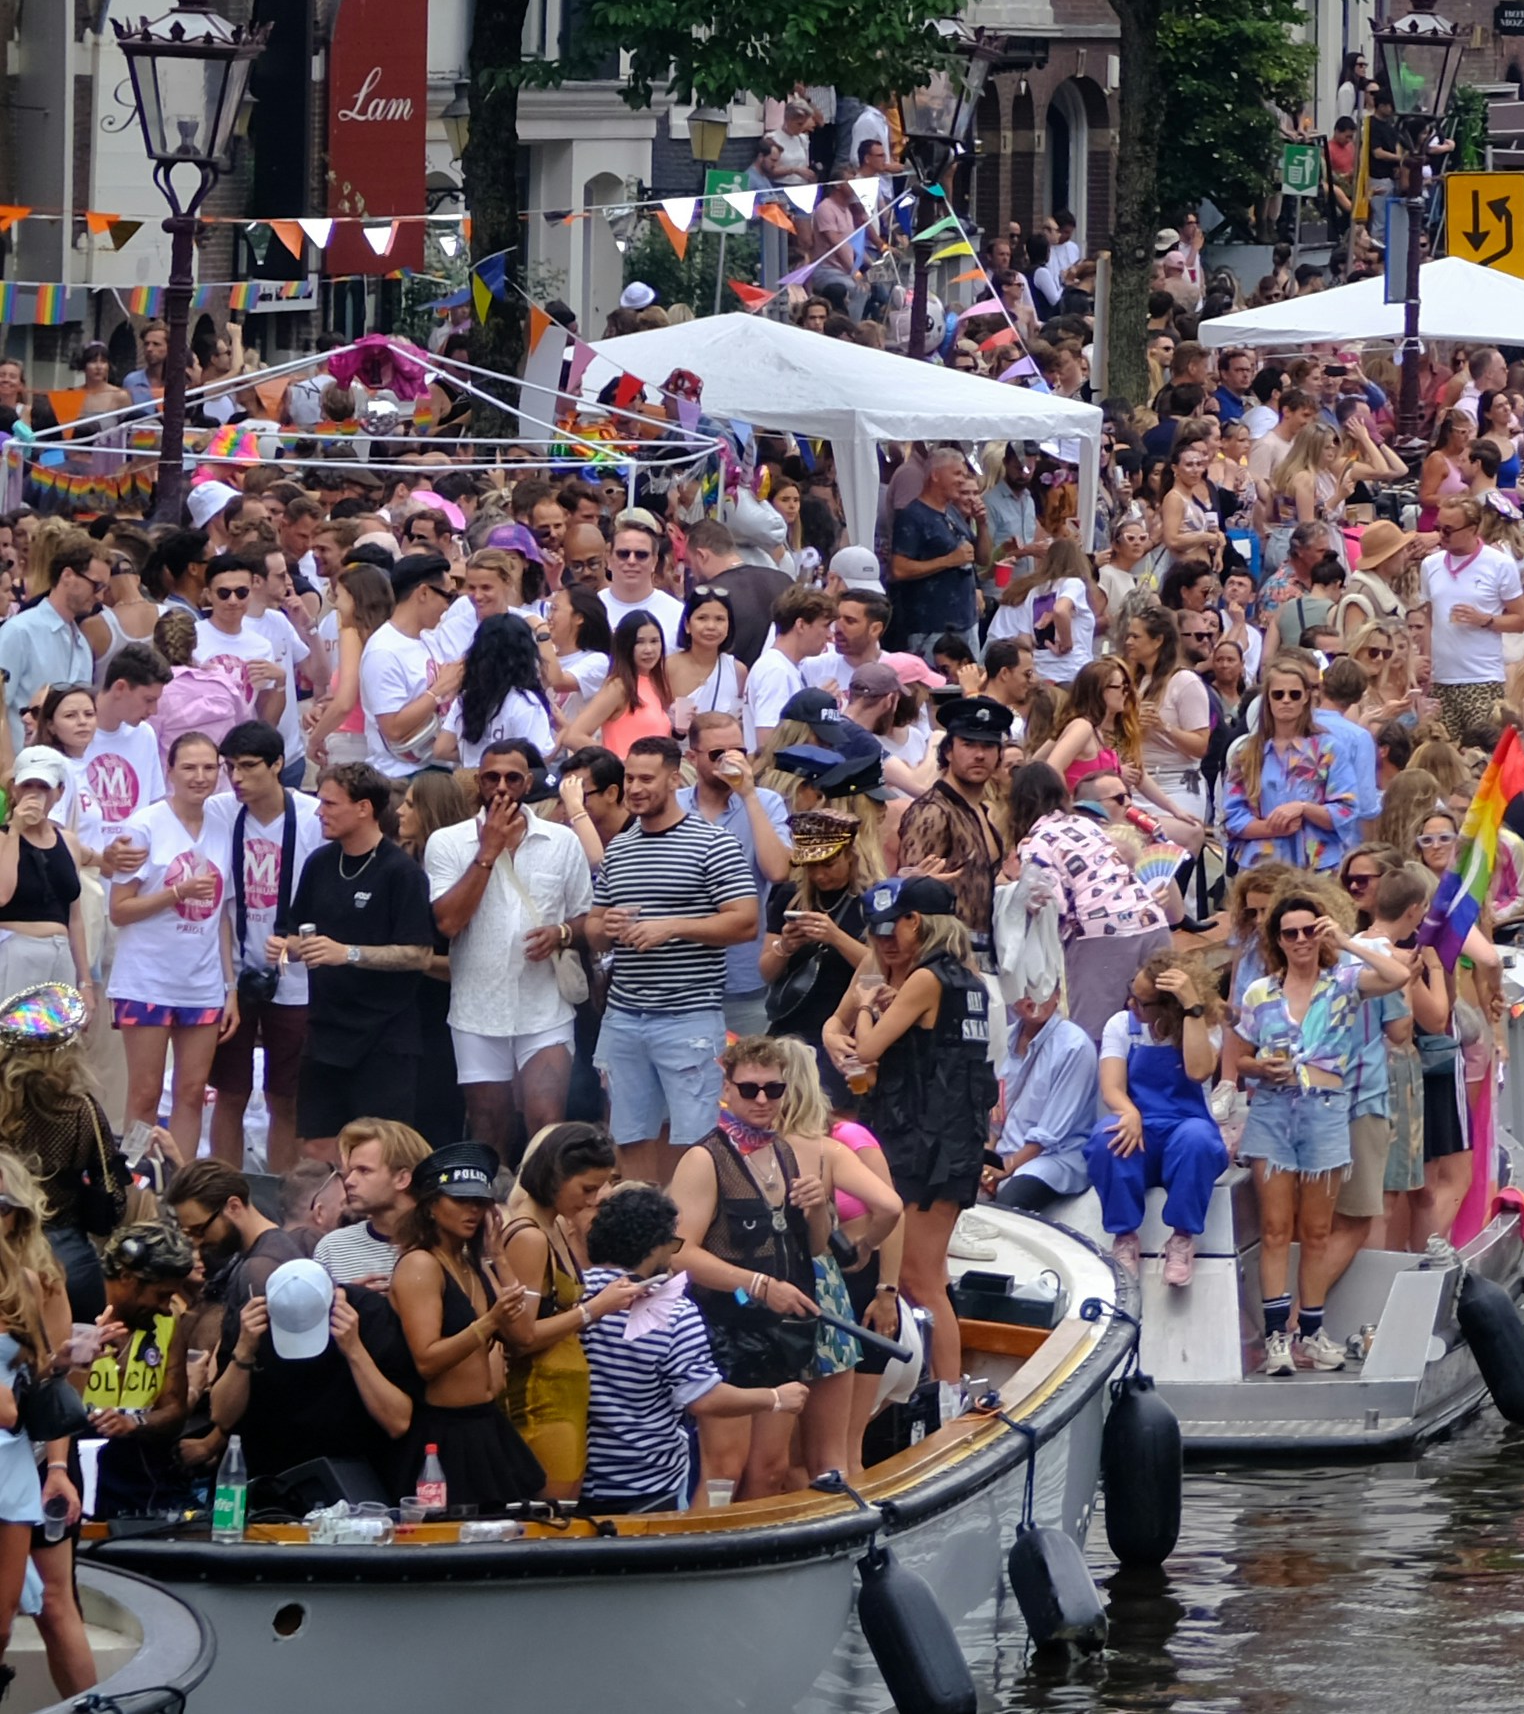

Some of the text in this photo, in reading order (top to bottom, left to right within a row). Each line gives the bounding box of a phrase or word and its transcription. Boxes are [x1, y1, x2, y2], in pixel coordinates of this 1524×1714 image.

[338, 67, 414, 122] Lam
[97, 766, 128, 798] M
[100, 826, 122, 835] PRID
[244, 852, 276, 886] M
[176, 923, 205, 934] PRIDE
[246, 913, 268, 924] RIDE
[87, 1370, 158, 1392] OLCIA
